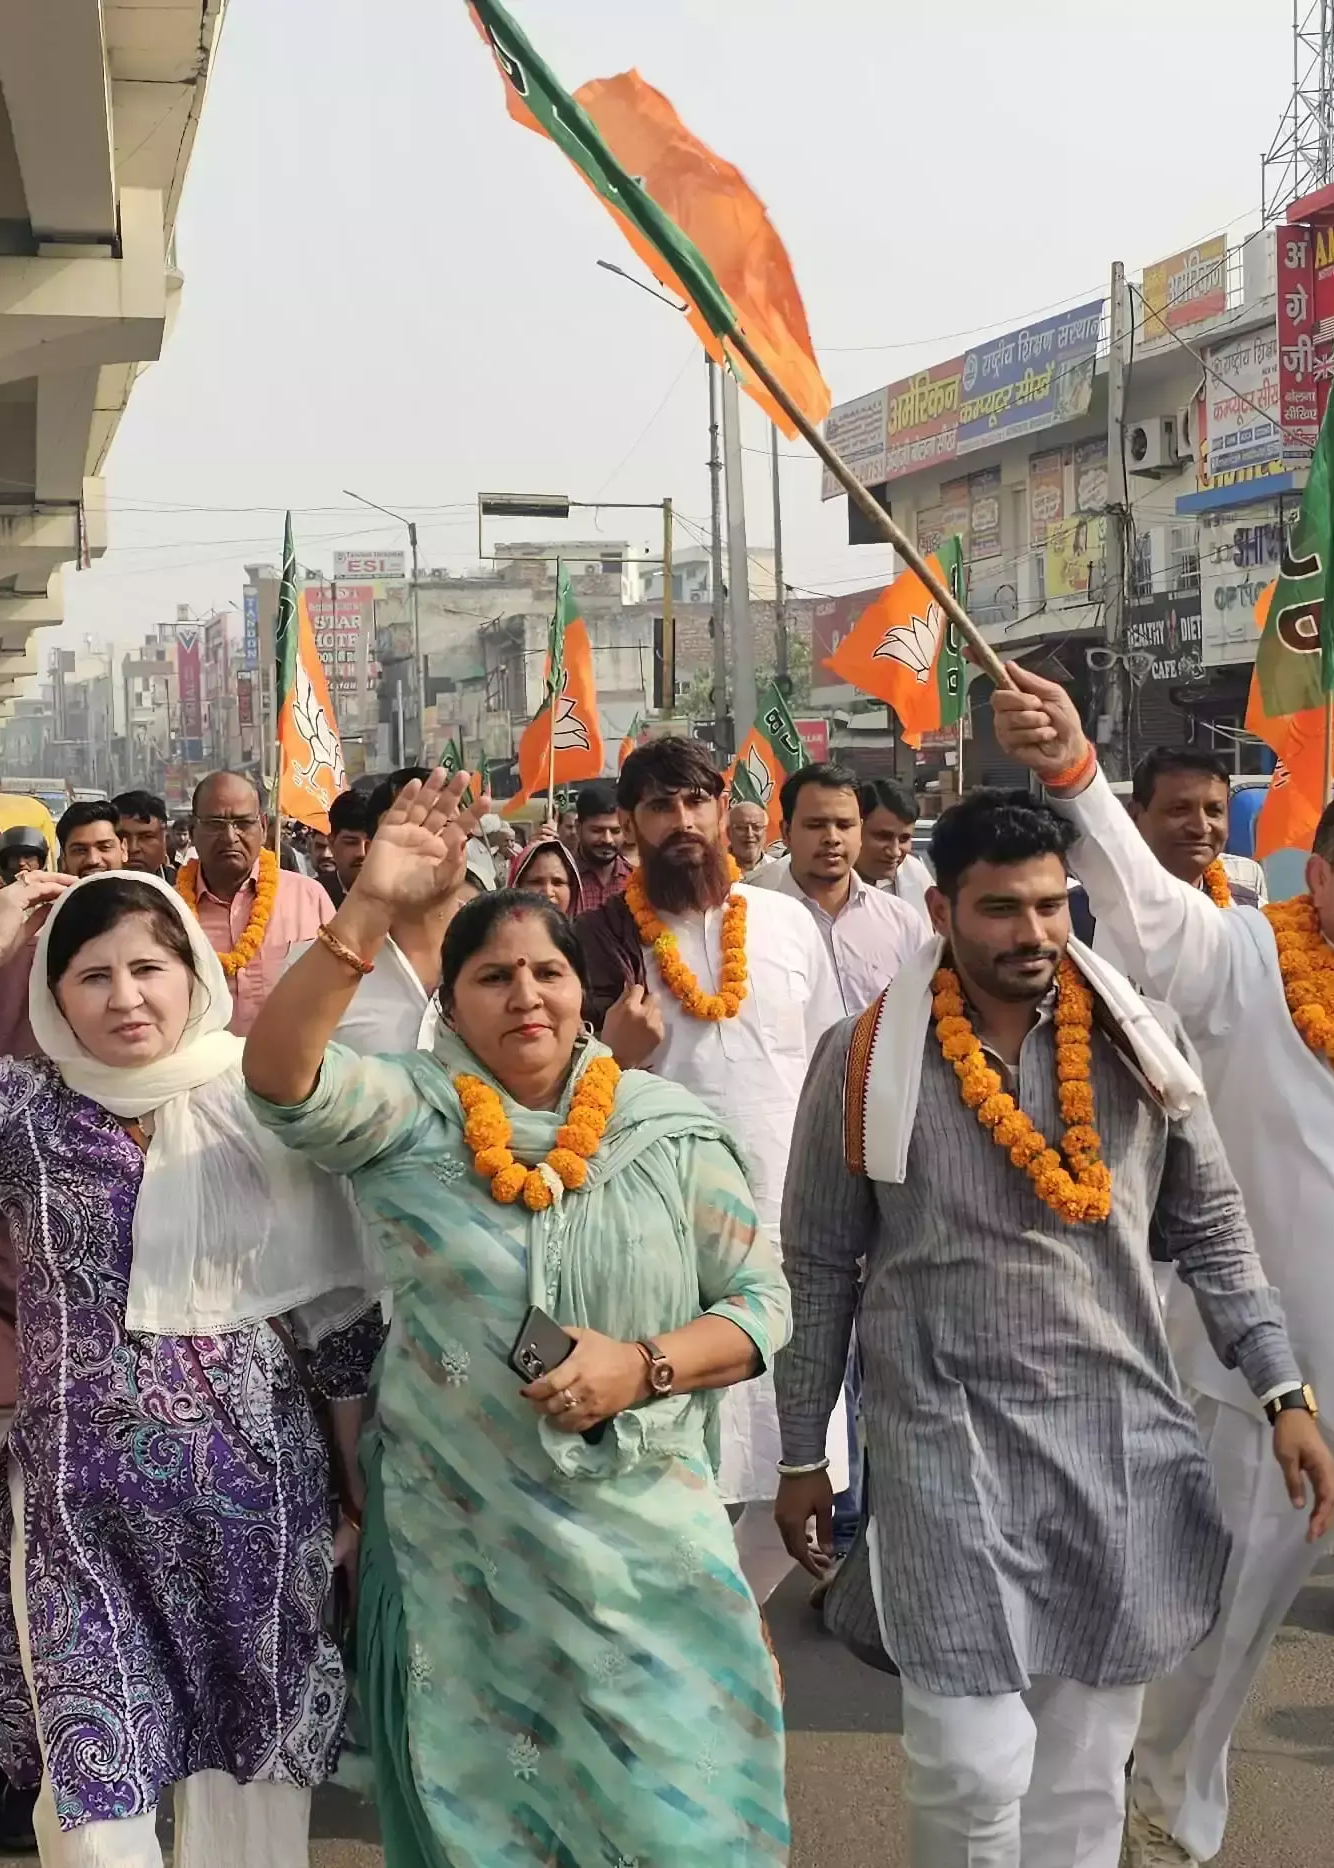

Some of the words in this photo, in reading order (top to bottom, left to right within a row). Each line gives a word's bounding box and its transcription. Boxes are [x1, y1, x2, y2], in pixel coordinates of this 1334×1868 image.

[348, 560, 385, 573] ESI
[1180, 614, 1201, 642] DIET
[1152, 660, 1178, 681] CAFE
